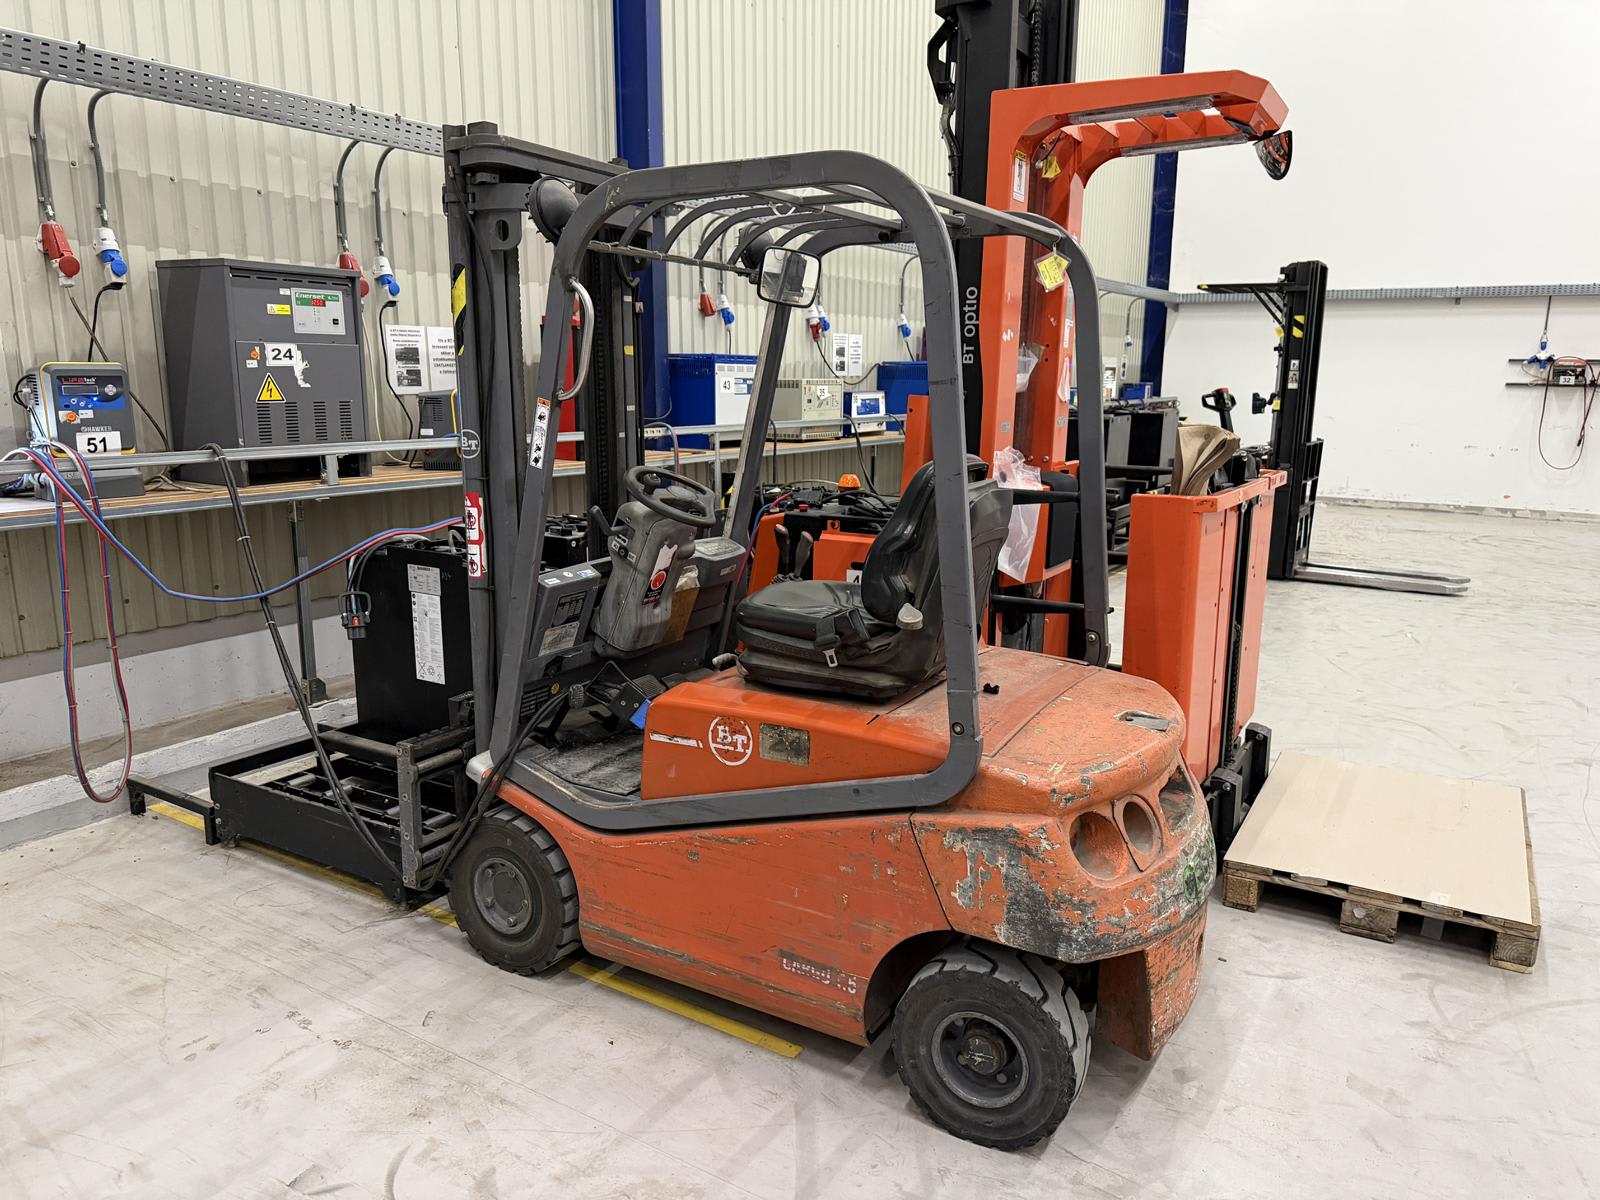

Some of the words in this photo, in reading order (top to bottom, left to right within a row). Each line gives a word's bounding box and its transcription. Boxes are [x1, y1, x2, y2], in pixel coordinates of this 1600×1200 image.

[295, 292, 327, 300] Enerset
[962, 286, 979, 337] optio
[271, 347, 294, 361] 24
[962, 343, 974, 364] BT
[722, 379, 731, 391] 43
[819, 388, 826, 397] 35
[86, 425, 113, 433] HAWKER
[87, 436, 107, 454] 51
[716, 725, 748, 753] BT
